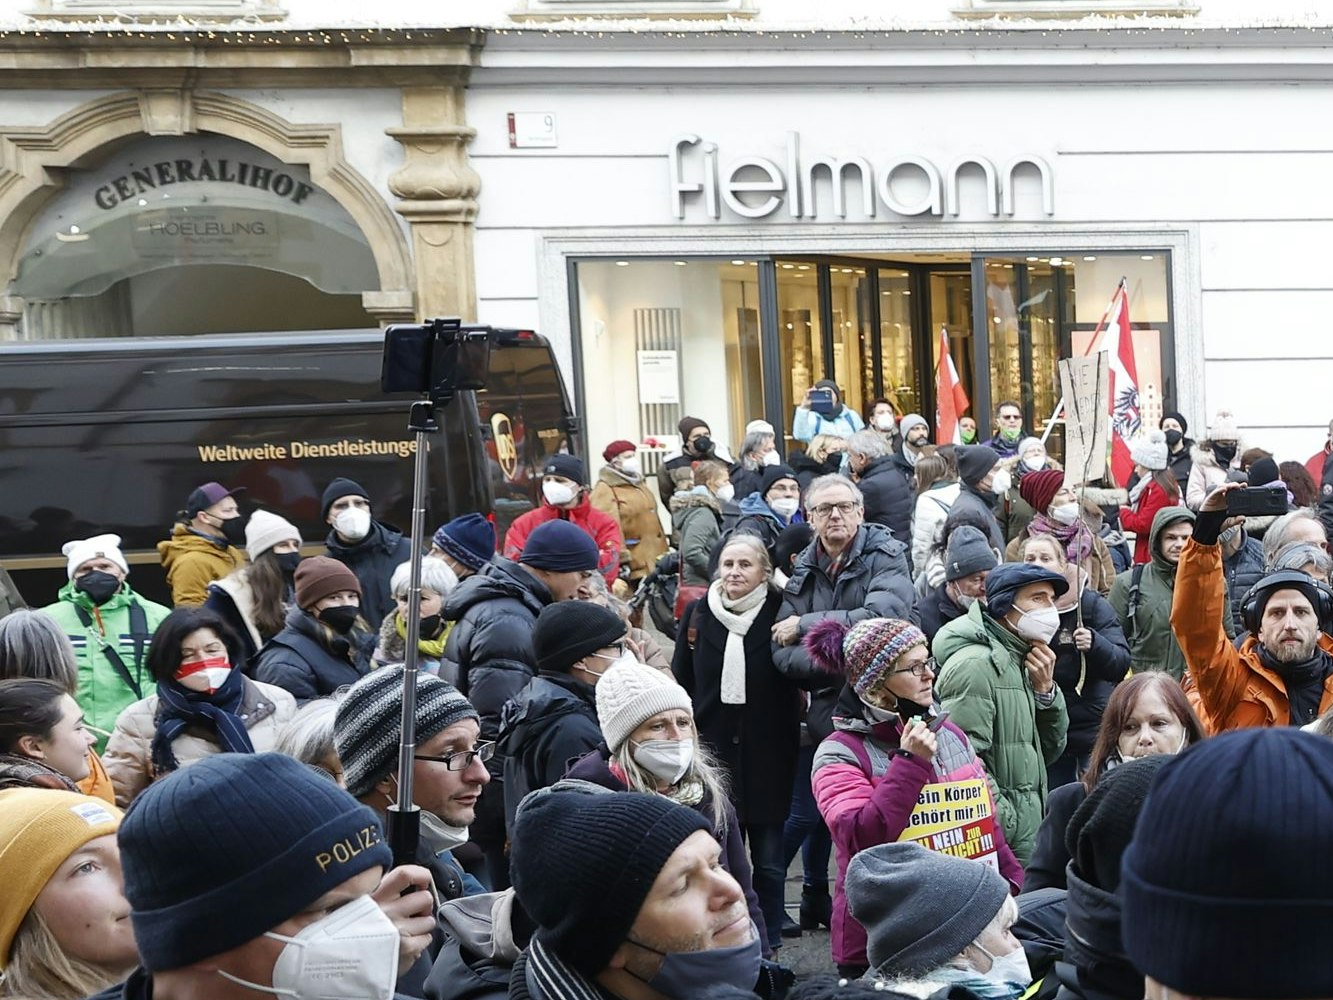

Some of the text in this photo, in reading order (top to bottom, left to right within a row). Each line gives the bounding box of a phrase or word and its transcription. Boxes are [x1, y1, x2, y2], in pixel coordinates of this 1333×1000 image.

[544, 115, 553, 133] 9
[95, 158, 314, 210] GENERALIHOF
[670, 131, 1054, 219] fielmann
[199, 443, 288, 462] Weltweite
[917, 786, 981, 805] ein Körper
[912, 803, 987, 826] ehört mir !!!
[932, 828, 964, 851] NEIN
[966, 826, 981, 839] ZUR
